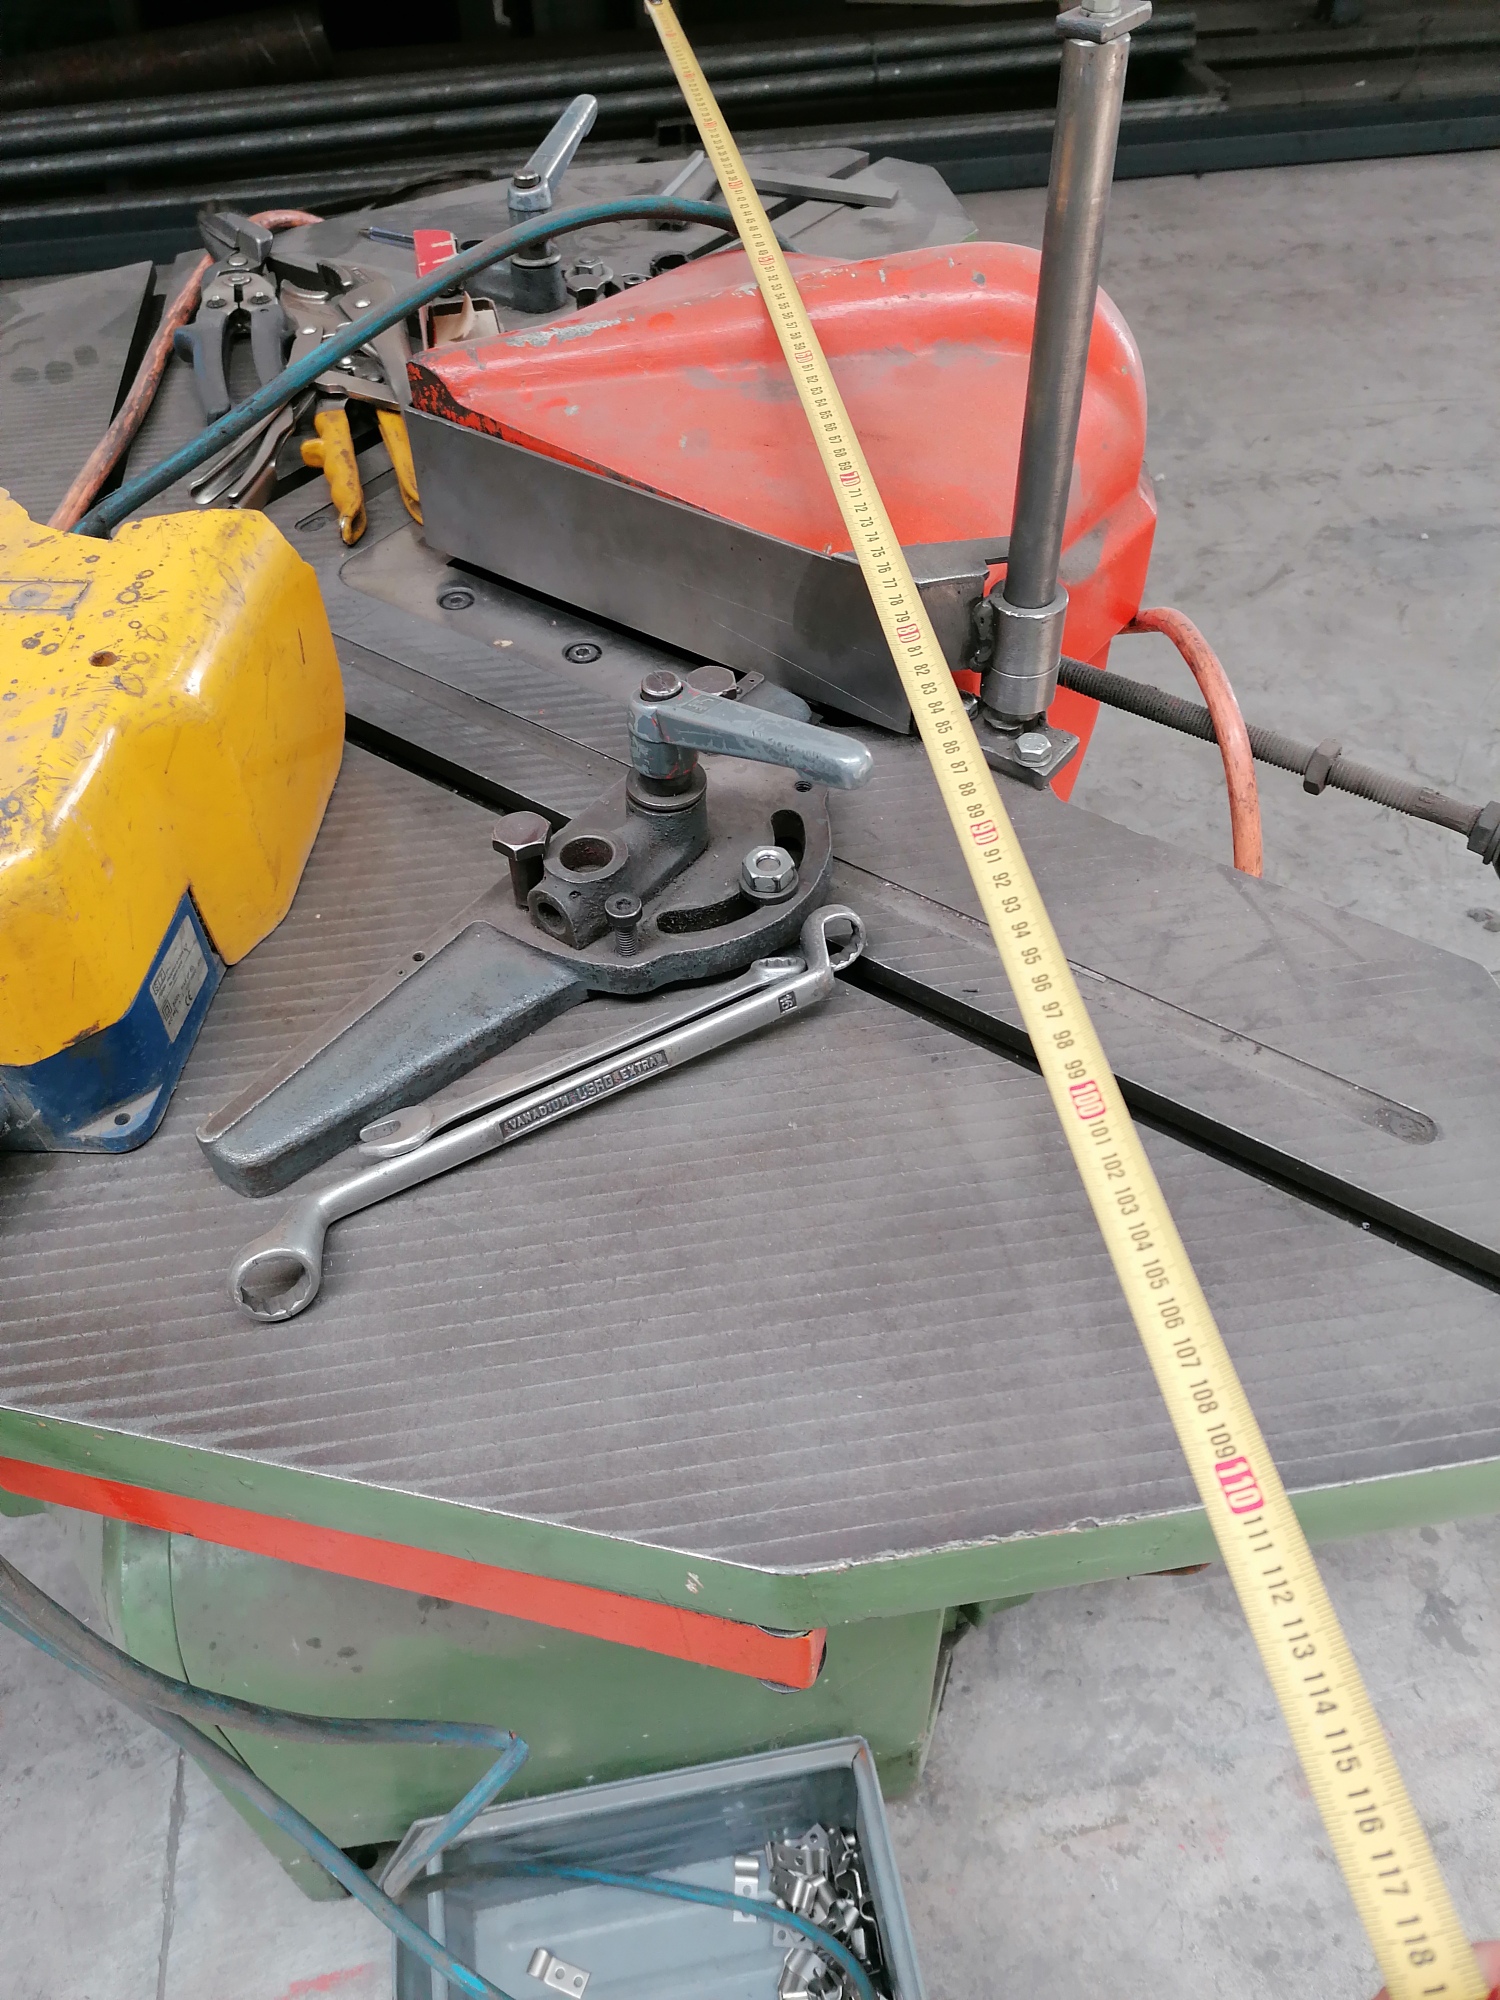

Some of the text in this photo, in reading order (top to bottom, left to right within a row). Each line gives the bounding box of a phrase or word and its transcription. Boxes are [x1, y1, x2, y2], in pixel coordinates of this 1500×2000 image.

[801, 363, 814, 372] 61
[805, 375, 819, 384] 62
[810, 386, 823, 396] 63
[814, 398, 828, 407] 64
[819, 410, 833, 420] 65
[823, 422, 838, 432] 66
[828, 435, 843, 444] 67
[833, 447, 848, 458] 68
[838, 461, 853, 471] 69
[848, 488, 863, 498] 71
[853, 502, 868, 513] 72
[859, 516, 874, 528] 73
[864, 531, 880, 543] 74
[870, 546, 886, 558] 75
[876, 561, 892, 574] 76
[882, 577, 898, 589] 77
[888, 593, 904, 606] 78
[894, 610, 911, 623] 79
[896, 623, 921, 644] 80
[907, 645, 924, 658] 81
[913, 663, 931, 677] 82
[920, 681, 938, 695] 83
[927, 700, 945, 715] 84
[935, 720, 953, 734] 85
[942, 740, 961, 755] 86
[950, 760, 969, 774] 87
[958, 781, 977, 797] 88
[966, 803, 985, 819] 89
[970, 819, 1000, 846] 90
[983, 848, 1002, 864] 91
[992, 872, 1012, 889] 92
[1001, 896, 1022, 914] 93
[1011, 921, 1031, 939] 94
[1021, 947, 1042, 965] 95
[1031, 974, 1052, 993] 96
[1042, 1001, 1064, 1019] 97
[1053, 1030, 1075, 1050] 98
[1064, 1059, 1087, 1080] 99
[510, 1094, 571, 1130] VANADIUM
[620, 1056, 658, 1080] EXTRA
[1068, 1079, 1107, 1120] 100
[1088, 1120, 1112, 1146] 101
[1100, 1152, 1126, 1180] 102
[1114, 1186, 1139, 1216] 103
[1127, 1221, 1154, 1253] 104
[1142, 1258, 1170, 1291] 105
[1157, 1297, 1185, 1330] 106
[1172, 1337, 1202, 1369] 107
[1189, 1379, 1219, 1414] 108
[1206, 1422, 1237, 1460] 109
[1214, 1455, 1265, 1515] 110
[1243, 1515, 1274, 1553] 111
[1262, 1566, 1295, 1605] 112
[1282, 1617, 1316, 1661] 113
[1303, 1671, 1339, 1715] 114
[1324, 1727, 1363, 1773] 115
[1347, 1786, 1387, 1835] 116
[1371, 1848, 1411, 1897] 117
[1395, 1914, 1436, 1968] 118
